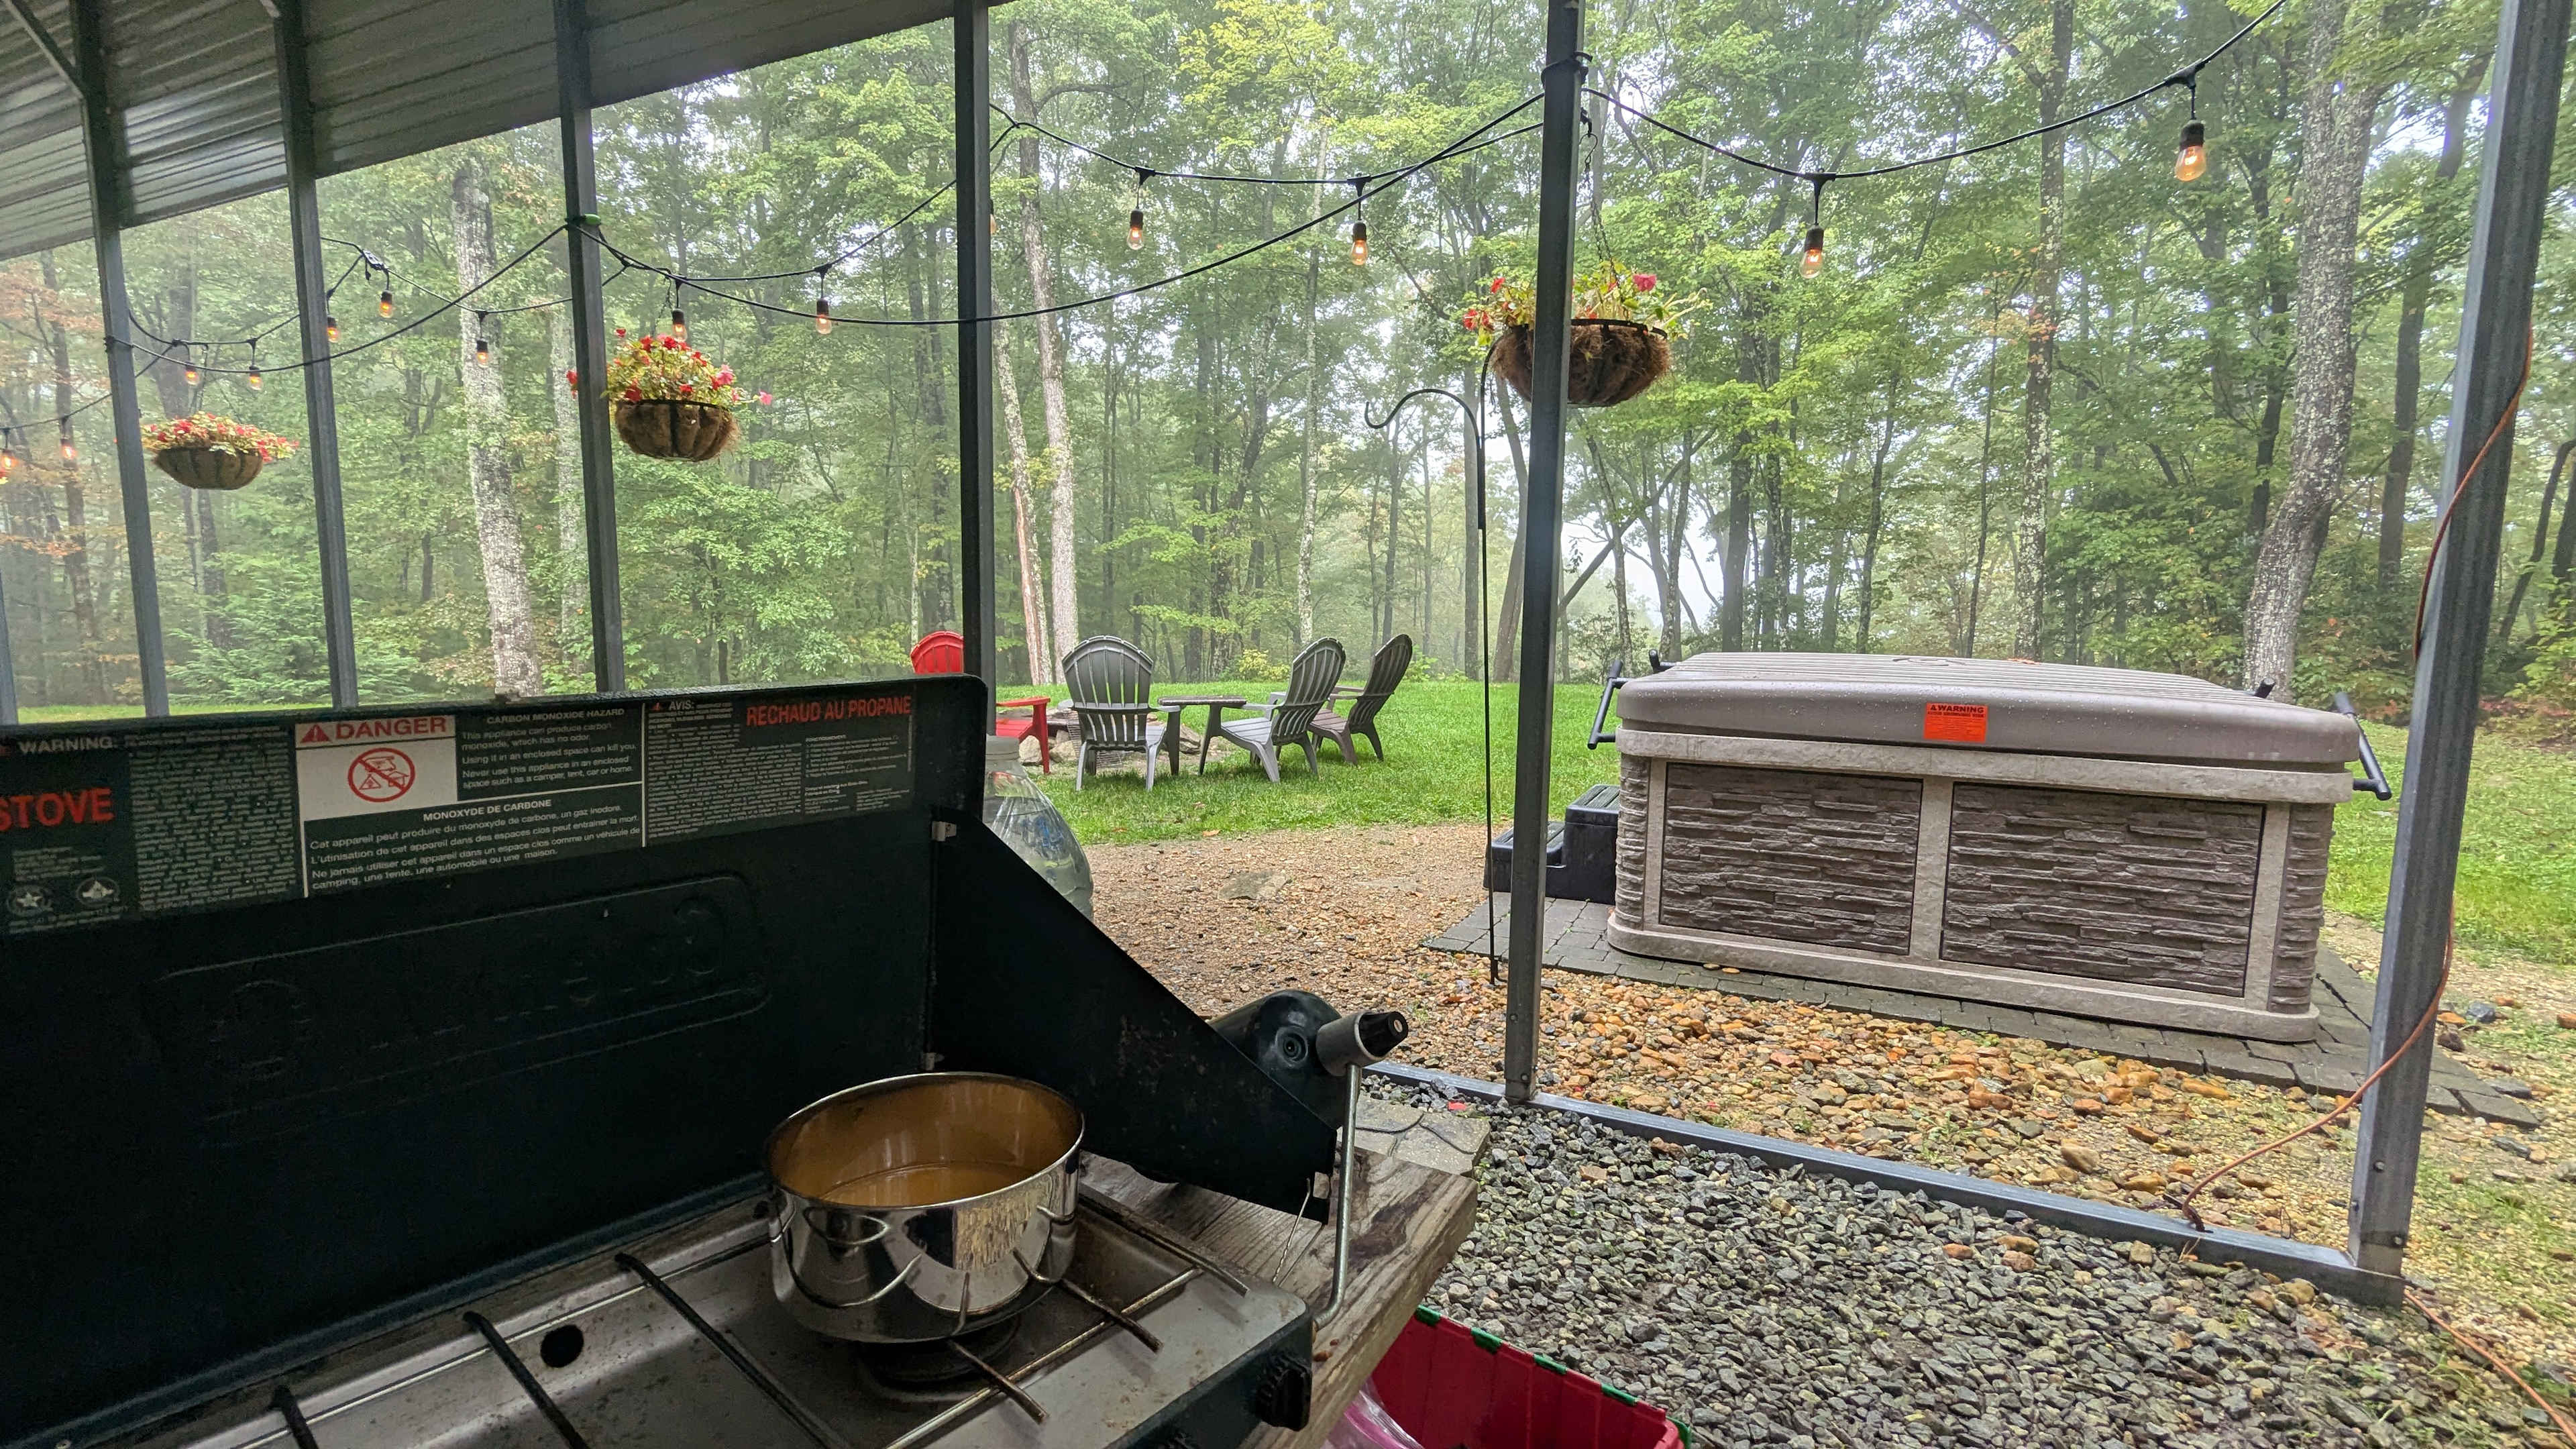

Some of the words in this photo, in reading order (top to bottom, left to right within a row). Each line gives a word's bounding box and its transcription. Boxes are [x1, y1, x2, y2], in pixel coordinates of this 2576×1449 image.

[487, 714, 530, 724] CARBON
[533, 711, 584, 721] MONOXIDE
[586, 708, 625, 718] HAZARD
[746, 702, 822, 726] RECHAUD
[824, 701, 845, 720] AU
[848, 696, 912, 718] PROPANE
[1937, 705, 1984, 713] WARNING
[336, 717, 446, 739] DANGER
[462, 754, 488, 765] Using
[498, 753, 507, 762] in
[510, 752, 521, 761] an
[523, 748, 562, 759] enclosed
[564, 747, 589, 757] space
[590, 745, 605, 754] can
[607, 743, 619, 751] kill
[462, 769, 490, 779] Never
[492, 766, 507, 776] use
[510, 764, 526, 774] this
[528, 761, 570, 773] appliance
[572, 759, 579, 768] in
[580, 758, 591, 767] an
[592, 755, 629, 766] enclosed
[491, 776, 513, 786] such
[515, 775, 524, 784] as
[586, 767, 598, 776] car
[600, 767, 609, 775] or
[423, 807, 484, 822] MONOXYDE
[487, 804, 501, 814] DE
[503, 799, 552, 812] CARBONE
[310, 840, 329, 850] Cet
[332, 834, 374, 849] appareil
[376, 831, 398, 843] peut
[402, 824, 442, 839] produire
[443, 823, 456, 833] du
[458, 816, 506, 832] monoxyde
[508, 814, 520, 824] de
[561, 810, 572, 818] un
[574, 808, 588, 818] gaz
[376, 847, 389, 857] de
[391, 845, 407, 855] cet
[409, 839, 448, 854] appareil
[450, 837, 474, 847] dans
[475, 833, 492, 843] des
[494, 828, 531, 842] espaces
[533, 825, 551, 835] clos
[552, 823, 571, 835] peut
[610, 816, 618, 825] la
[312, 869, 328, 879] Ne
[330, 865, 364, 878] jamais
[366, 860, 399, 872] utiliser
[402, 857, 418, 867] cet
[419, 852, 458, 866] appareil
[459, 848, 482, 859] dans
[484, 846, 496, 855] un
[498, 841, 530, 854] espace
[531, 837, 549, 849] clos
[551, 835, 583, 845] comme
[584, 833, 595, 842] un
[630, 826, 641, 835] de
[364, 873, 383, 883] une
[416, 865, 435, 875] une
[436, 857, 488, 871] automobile
[490, 855, 501, 865] ou
[503, 853, 520, 863] une
